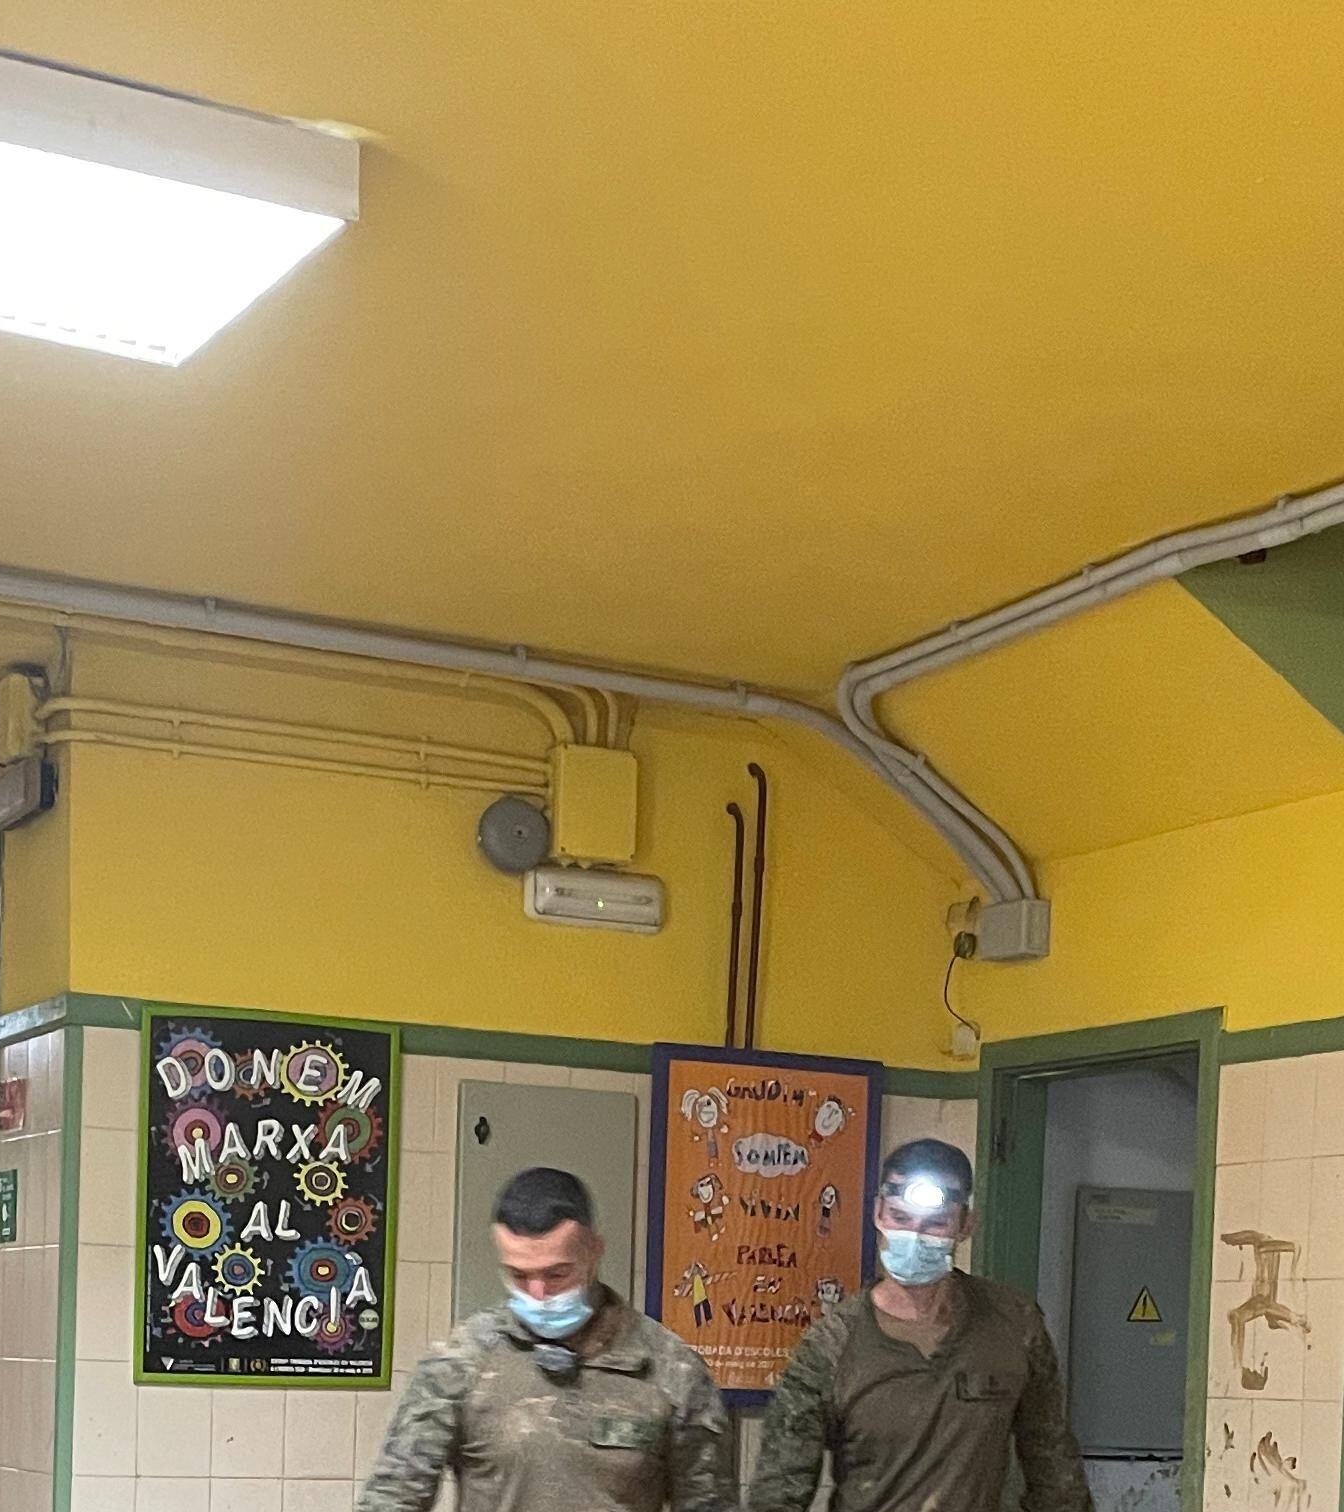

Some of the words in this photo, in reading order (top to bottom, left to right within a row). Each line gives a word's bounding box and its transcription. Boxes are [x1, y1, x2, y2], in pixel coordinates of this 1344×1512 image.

[156, 1048, 381, 1113] DONEM
[177, 1119, 352, 1184] MARXA
[240, 1200, 301, 1243] AL
[153, 1244, 378, 1340] VALENCIÀ
[686, 1345, 733, 1356] ROBADA
